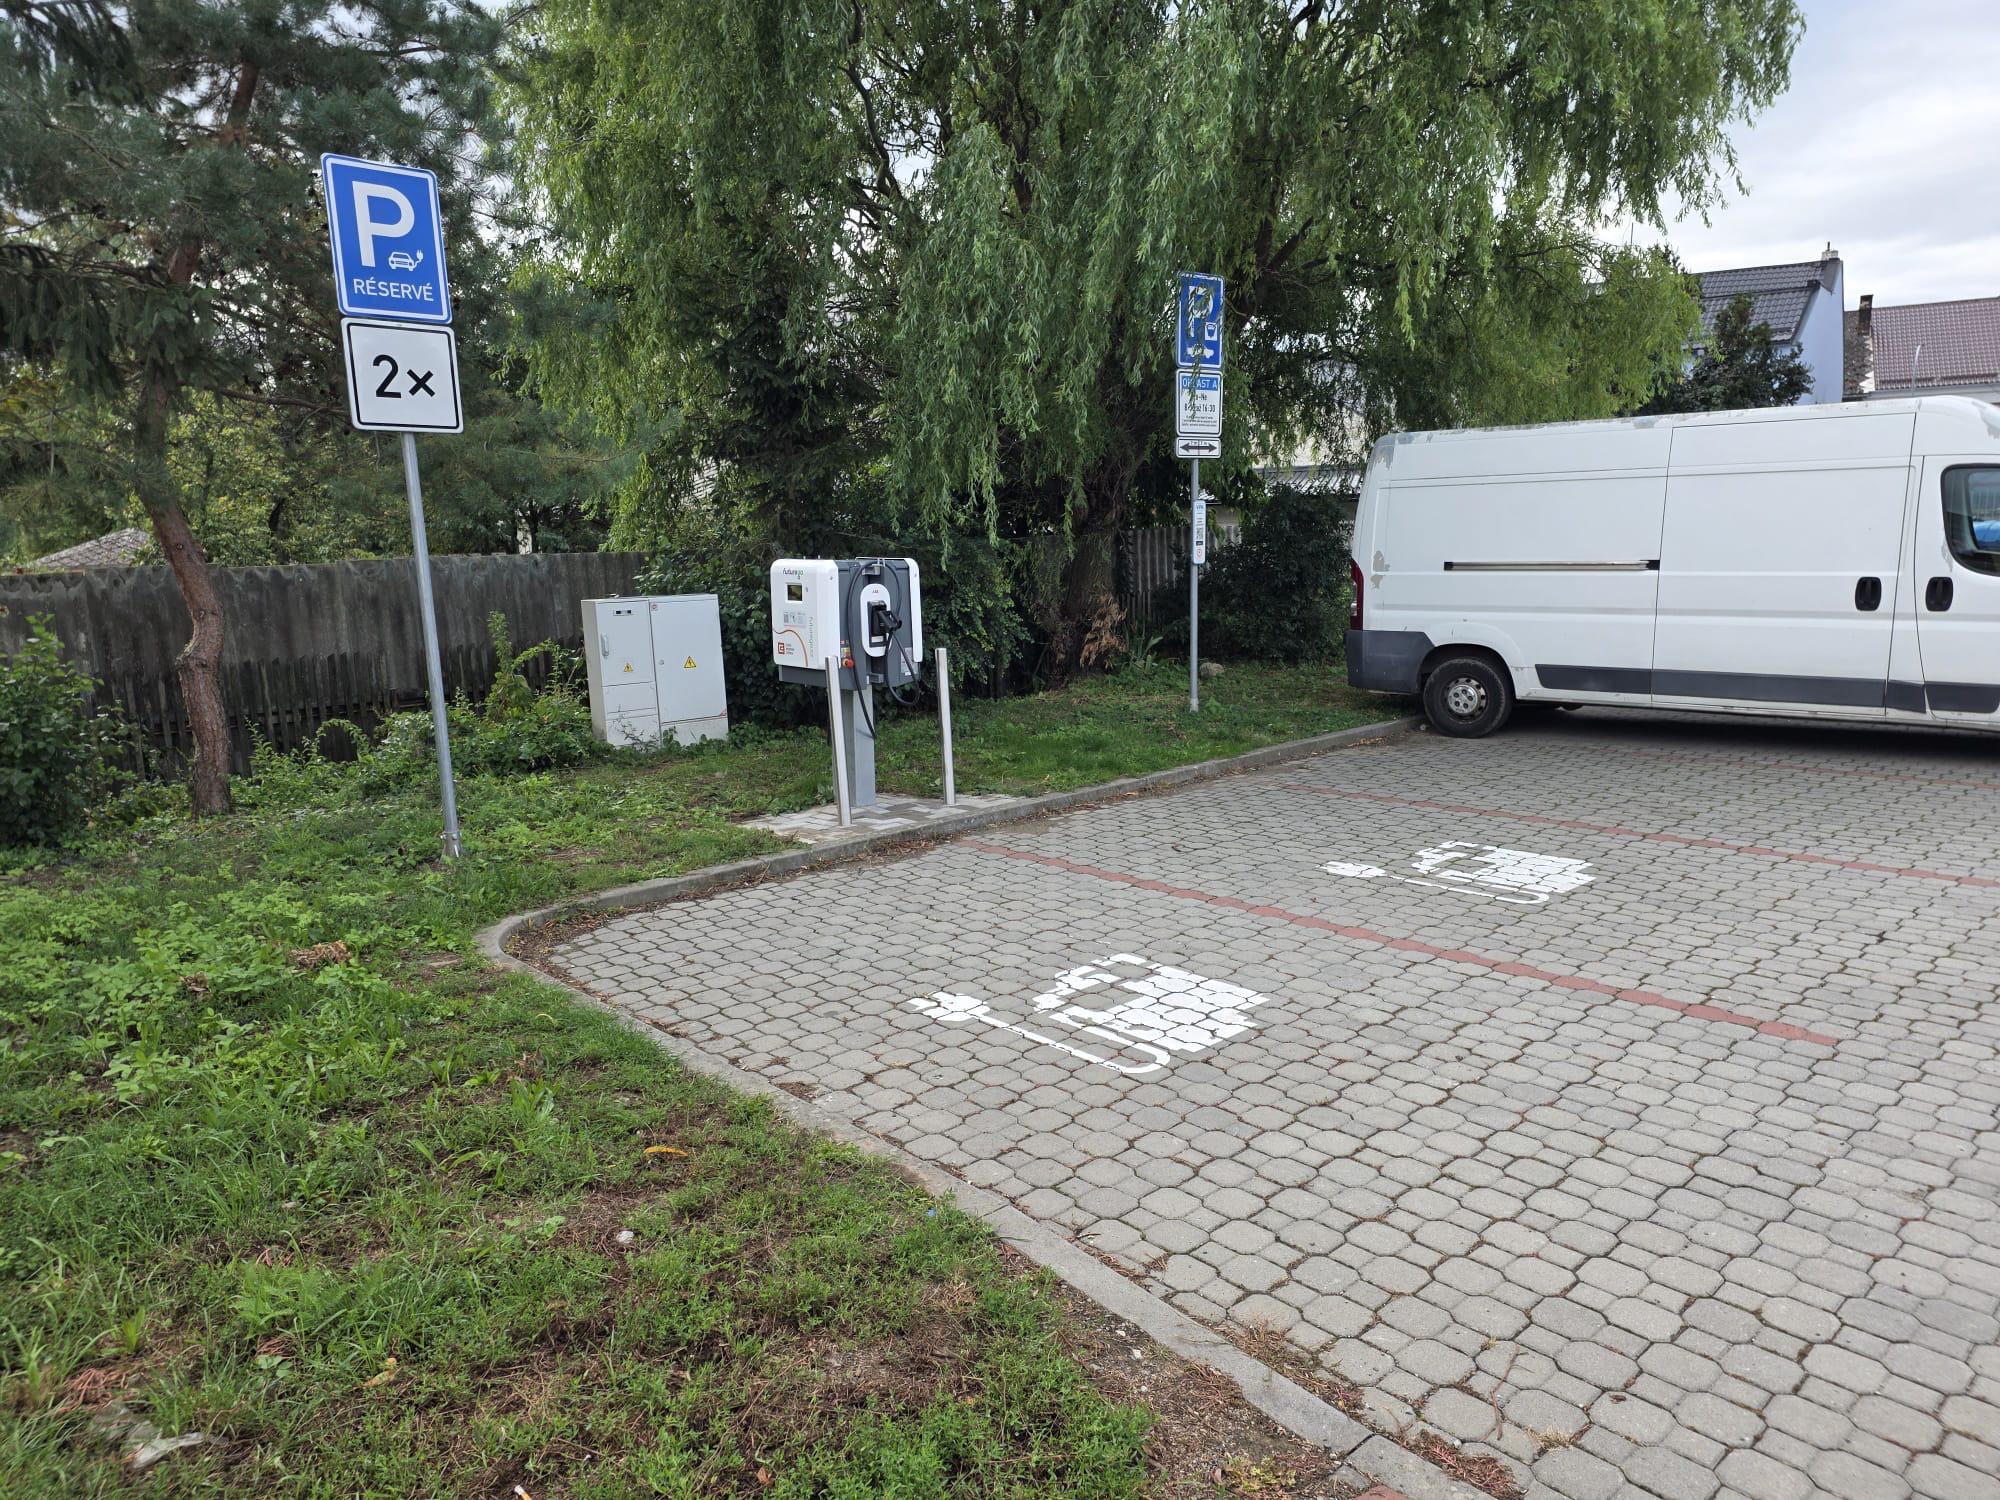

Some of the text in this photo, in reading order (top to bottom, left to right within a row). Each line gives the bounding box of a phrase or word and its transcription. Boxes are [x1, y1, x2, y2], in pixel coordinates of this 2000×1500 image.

[352, 181, 415, 267] P
[353, 276, 434, 302] RÉSERVÉ
[1188, 286, 1213, 337] P
[1212, 379, 1218, 389] A
